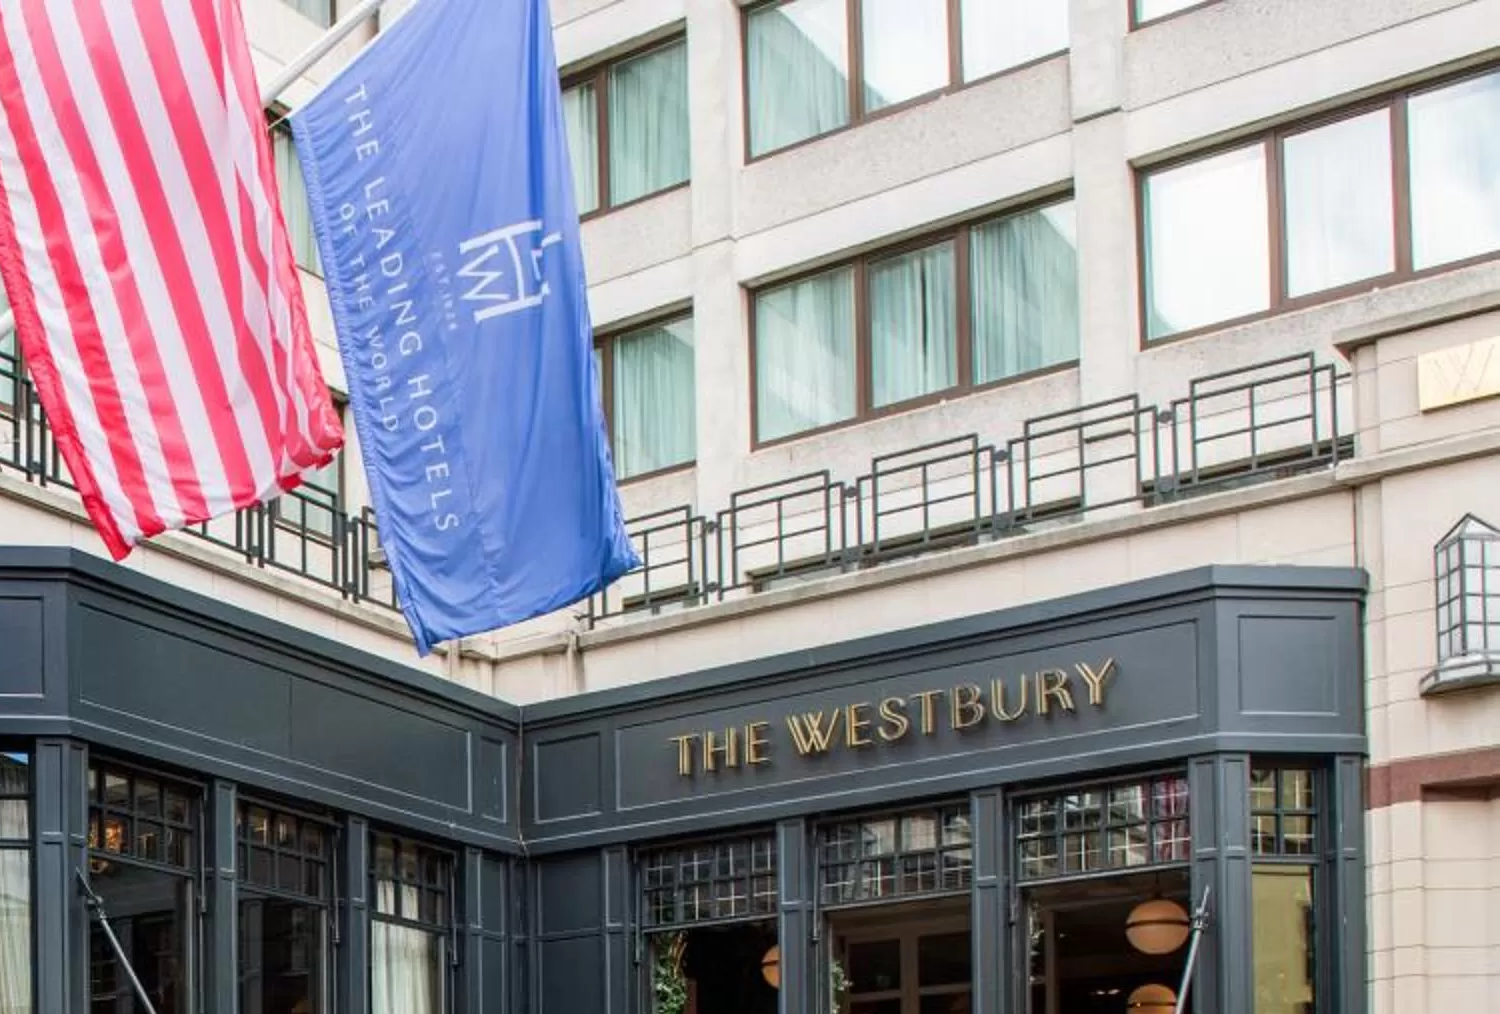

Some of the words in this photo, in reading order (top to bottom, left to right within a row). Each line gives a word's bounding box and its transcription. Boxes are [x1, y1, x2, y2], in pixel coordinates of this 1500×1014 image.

[338, 201, 358, 234] OF
[348, 246, 375, 312] THE
[368, 326, 399, 434] WORLD
[344, 83, 379, 162] THE
[365, 176, 423, 358] LEADING
[406, 373, 460, 532] HOTELS
[668, 720, 771, 776] THE
[786, 656, 1116, 756] WESTBURY
